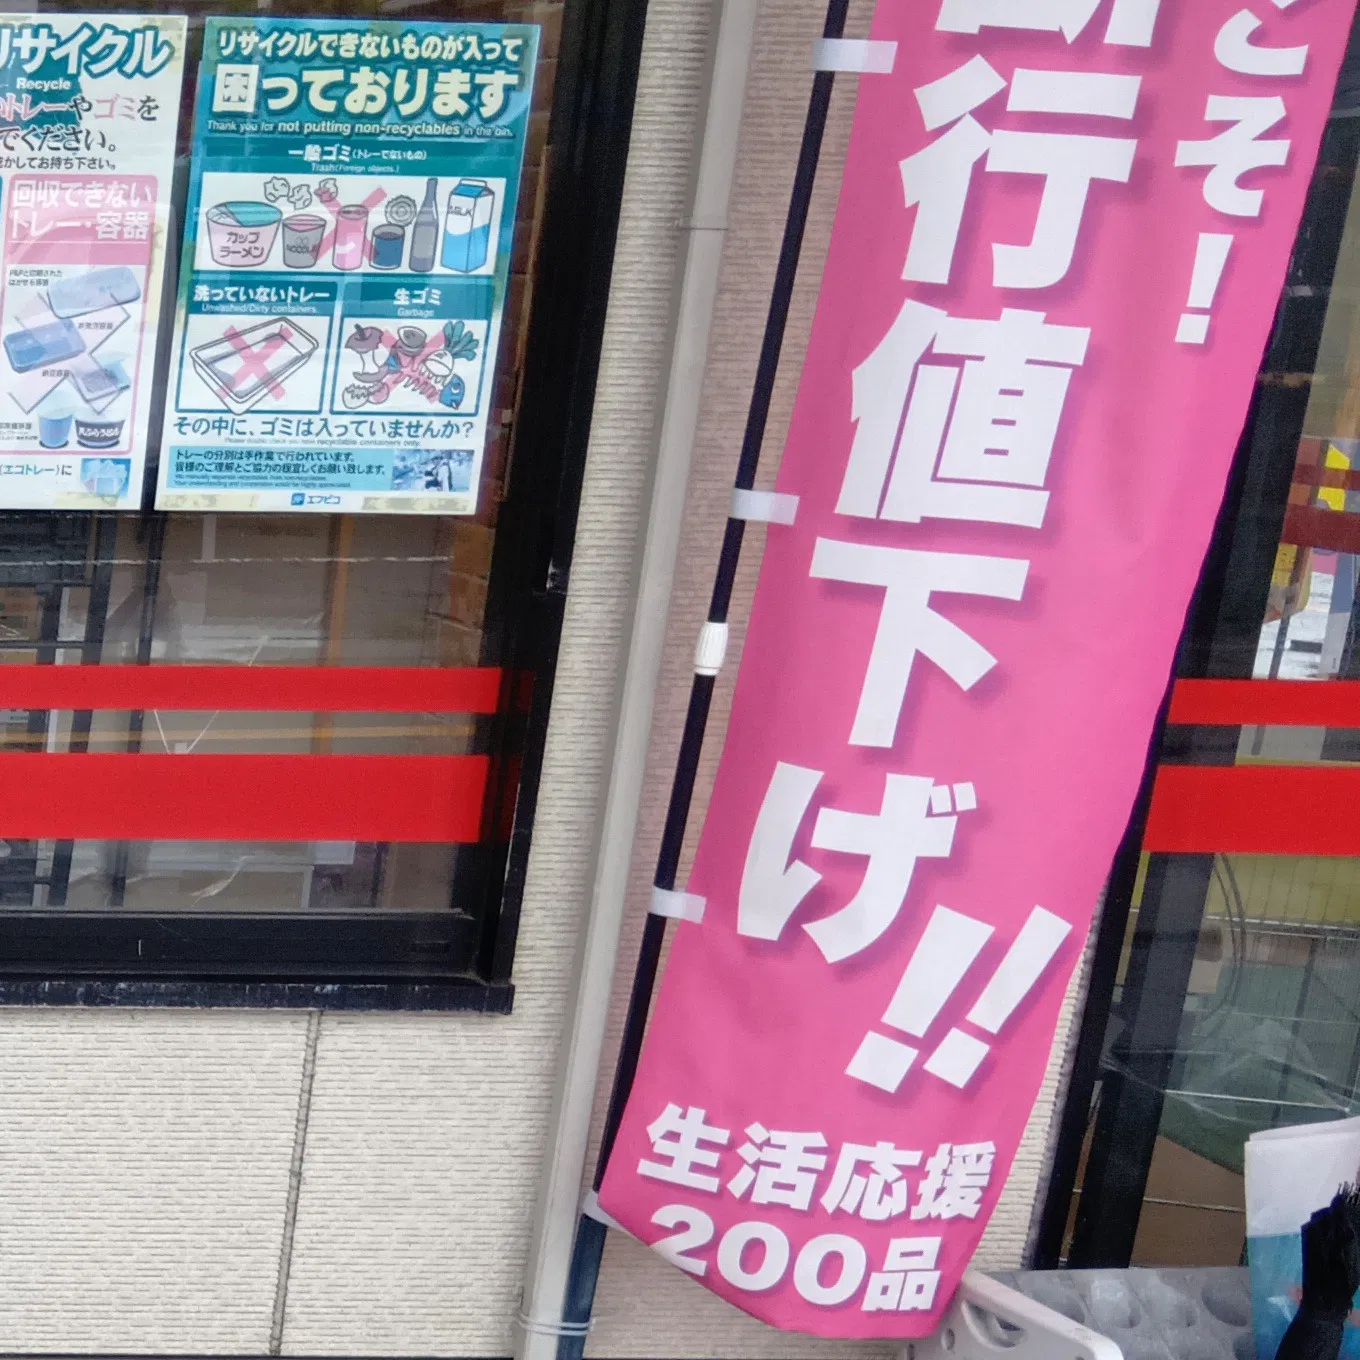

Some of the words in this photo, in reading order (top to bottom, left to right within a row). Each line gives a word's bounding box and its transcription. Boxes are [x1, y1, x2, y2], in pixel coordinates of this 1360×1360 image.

[219, 27, 523, 62] リサイクルできないものが入って
[16, 77, 72, 91] Recycle
[212, 63, 520, 119] 困っております
[207, 119, 237, 132] Thank
[239, 121, 259, 133] you
[278, 121, 300, 132] not
[304, 121, 352, 136] putting
[355, 122, 461, 137] non-recyclables
[13, 178, 153, 209] 回収できない
[11, 210, 149, 241] トレー・容器
[226, 231, 260, 244] カップ
[219, 246, 265, 259] ラーメン
[193, 285, 331, 303] 洗っていないトレー
[393, 287, 442, 306] 生ゴミ
[201, 303, 269, 315] Unwashed/Dirty
[270, 304, 319, 315] containers.
[397, 307, 435, 317] Garbage
[177, 450, 355, 463] トレーの分別は手作業で行われています。
[307, 494, 341, 505] エフピコ
[636, 1102, 997, 1221] 生活応援
[650, 1203, 943, 1313] 200品
